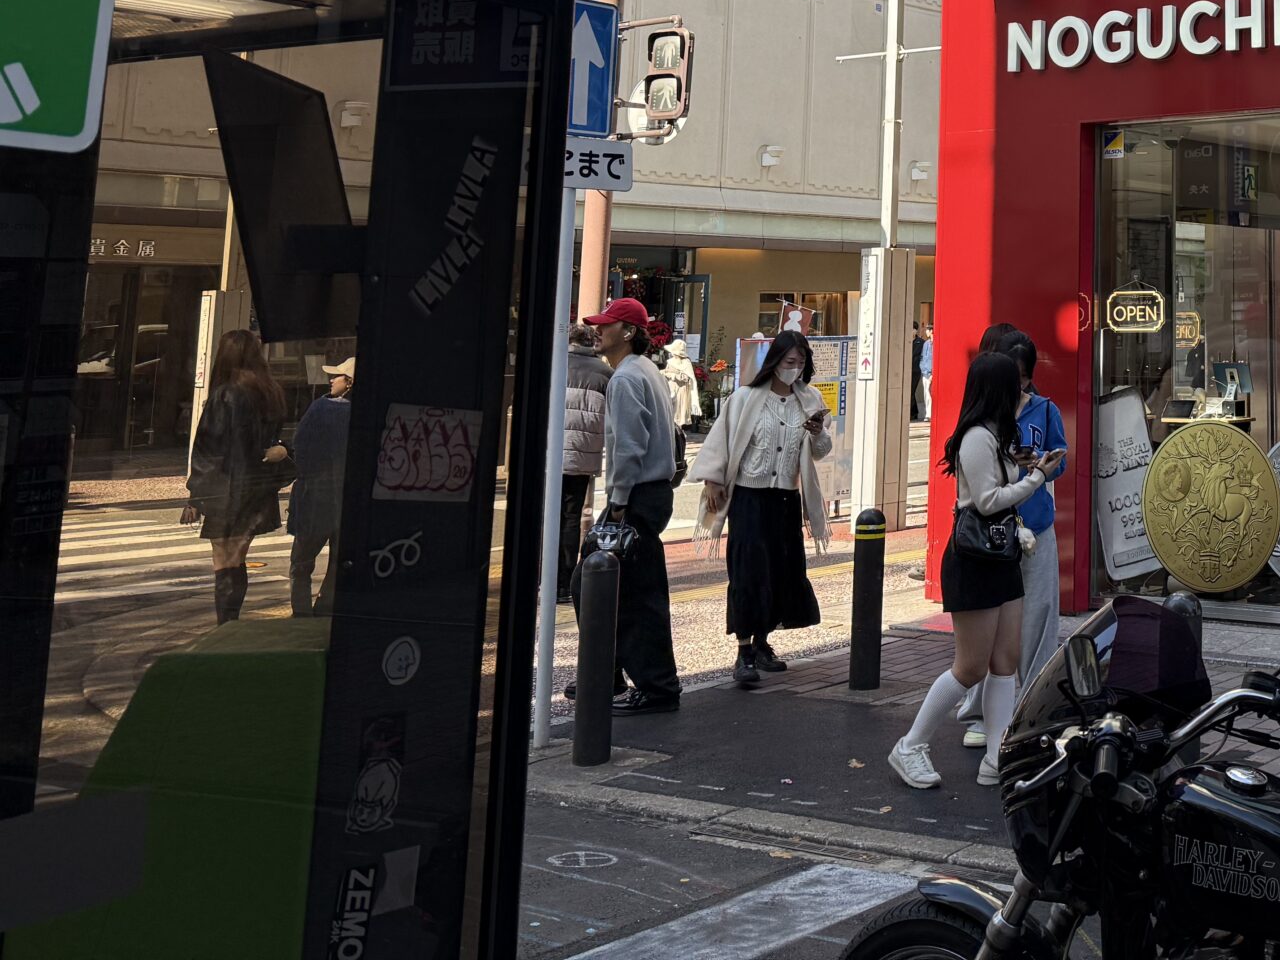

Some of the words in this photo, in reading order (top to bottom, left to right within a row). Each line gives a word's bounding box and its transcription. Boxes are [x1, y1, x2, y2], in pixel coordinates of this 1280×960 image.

[90, 239, 155, 257] 貴金属
[1113, 305, 1157, 322] OPEN
[1118, 437, 1134, 449] THE
[1119, 443, 1150, 460] ROYAL
[1119, 454, 1149, 472] MINT
[1173, 834, 1277, 873] HARLEY-
